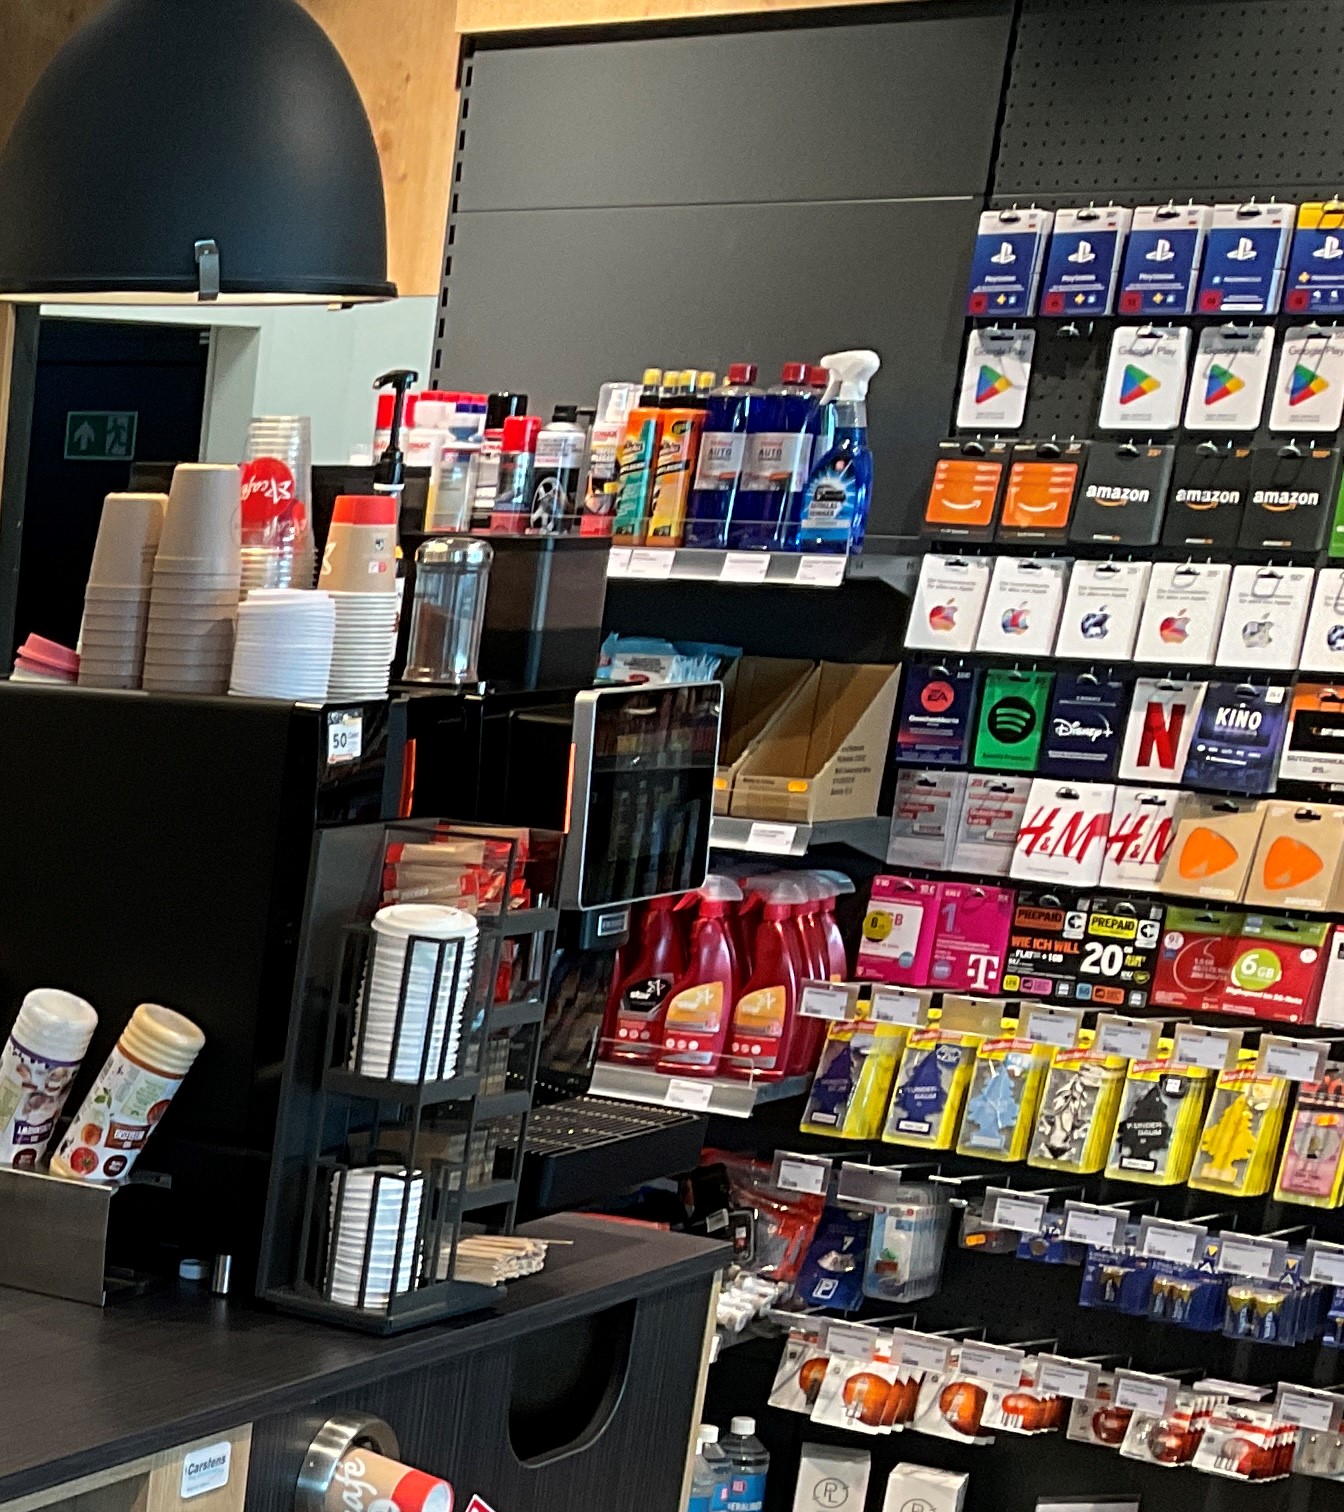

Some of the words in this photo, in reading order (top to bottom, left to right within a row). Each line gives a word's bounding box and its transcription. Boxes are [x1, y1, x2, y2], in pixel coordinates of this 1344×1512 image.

[1085, 484, 1150, 503] amazon
[1175, 488, 1240, 505] amazon
[1252, 489, 1319, 507] amazon
[1215, 706, 1263, 731] KINO
[1018, 806, 1112, 866] H&M
[1016, 908, 1062, 922] PREPAID
[1090, 916, 1135, 931] PREPAID
[1080, 941, 1124, 976] 20
[1240, 954, 1259, 976] 6
[1256, 964, 1275, 978] GB
